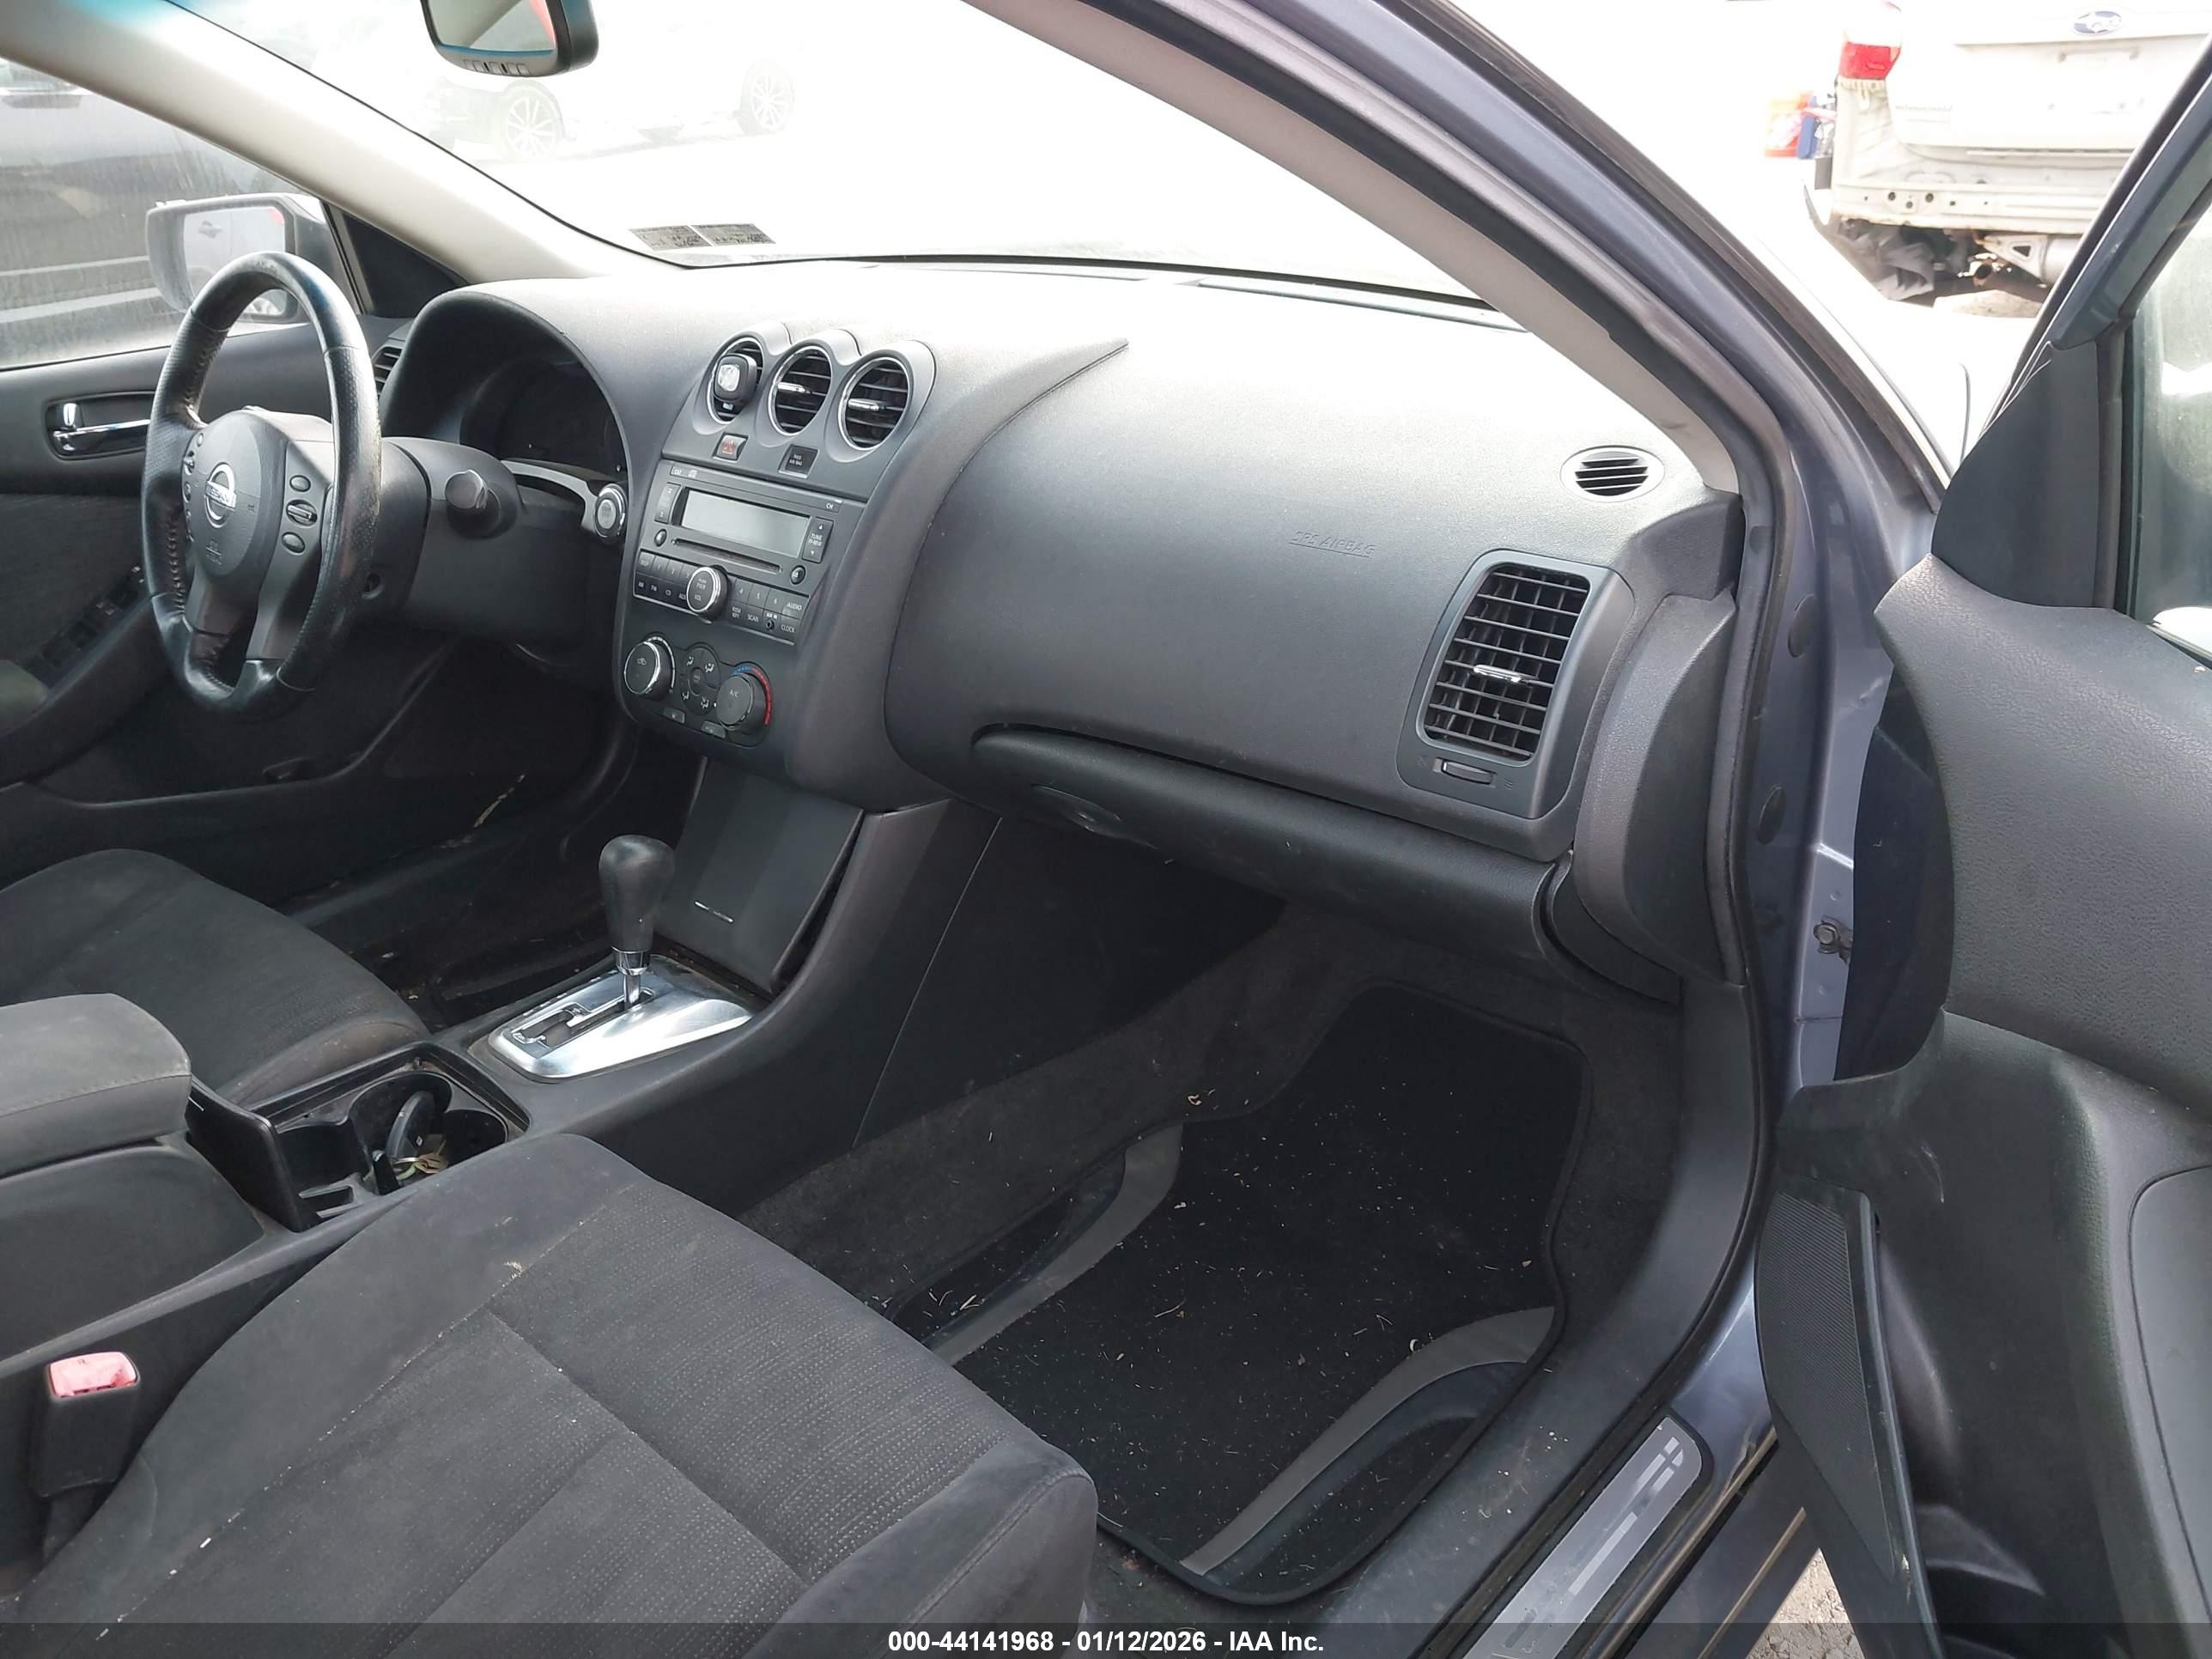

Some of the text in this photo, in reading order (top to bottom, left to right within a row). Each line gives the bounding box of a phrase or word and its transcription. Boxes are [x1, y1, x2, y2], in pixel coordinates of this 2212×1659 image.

[1318, 536, 1376, 555] AIRBAG
[787, 601, 802, 611] AUDIO
[747, 613, 759, 623] SCAN
[781, 623, 795, 634] CLOCK
